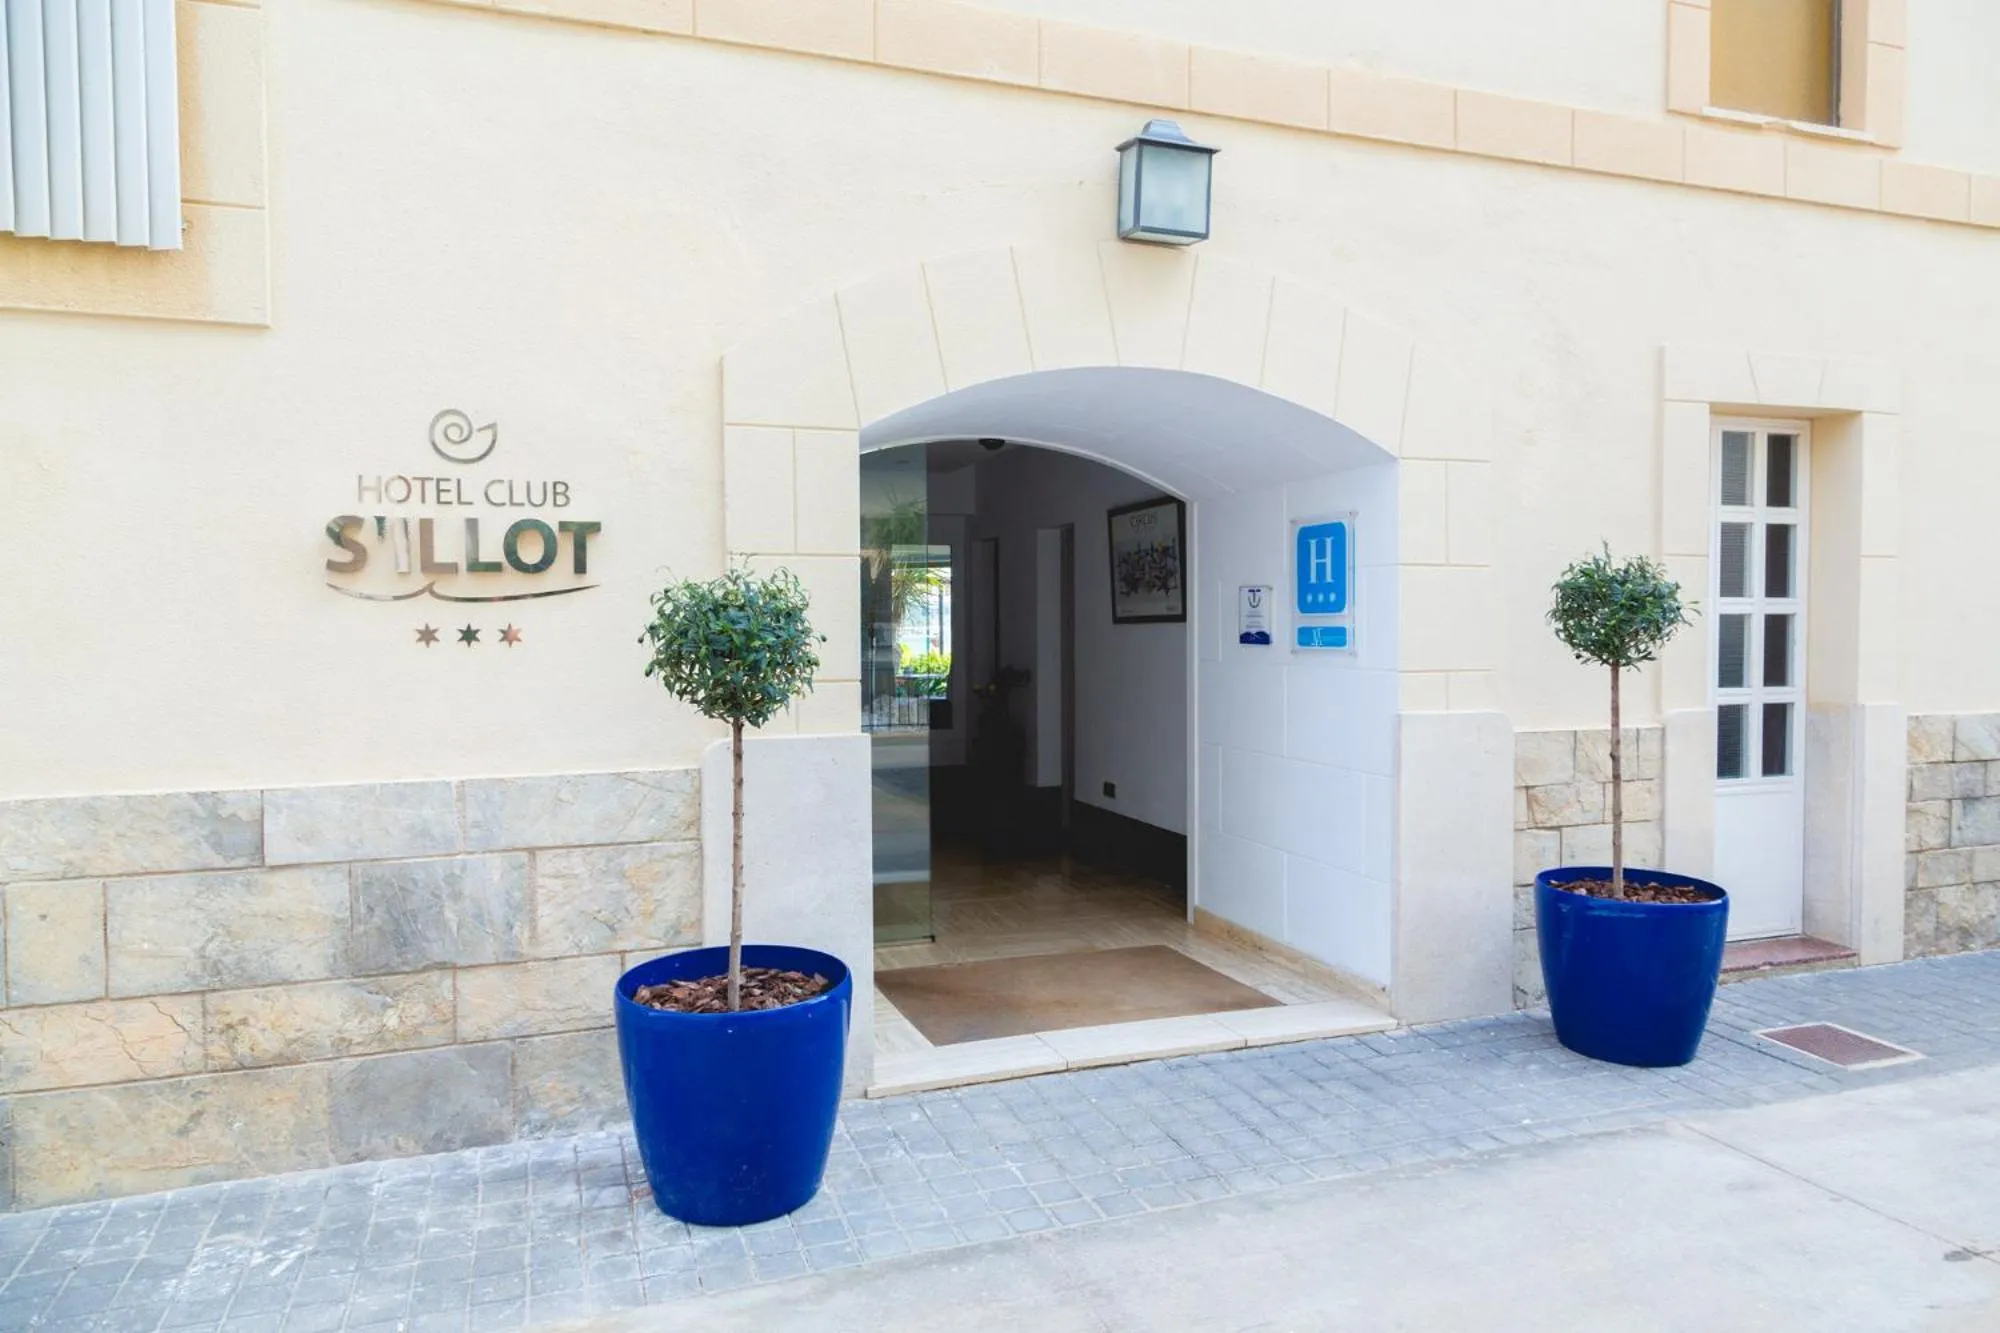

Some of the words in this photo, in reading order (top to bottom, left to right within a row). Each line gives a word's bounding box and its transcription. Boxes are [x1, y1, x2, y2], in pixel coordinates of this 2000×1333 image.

[357, 474, 474, 506] HOTEL
[484, 478, 572, 508] CLUB
[324, 514, 602, 575] S'ILLOT
[1308, 536, 1335, 585] H
